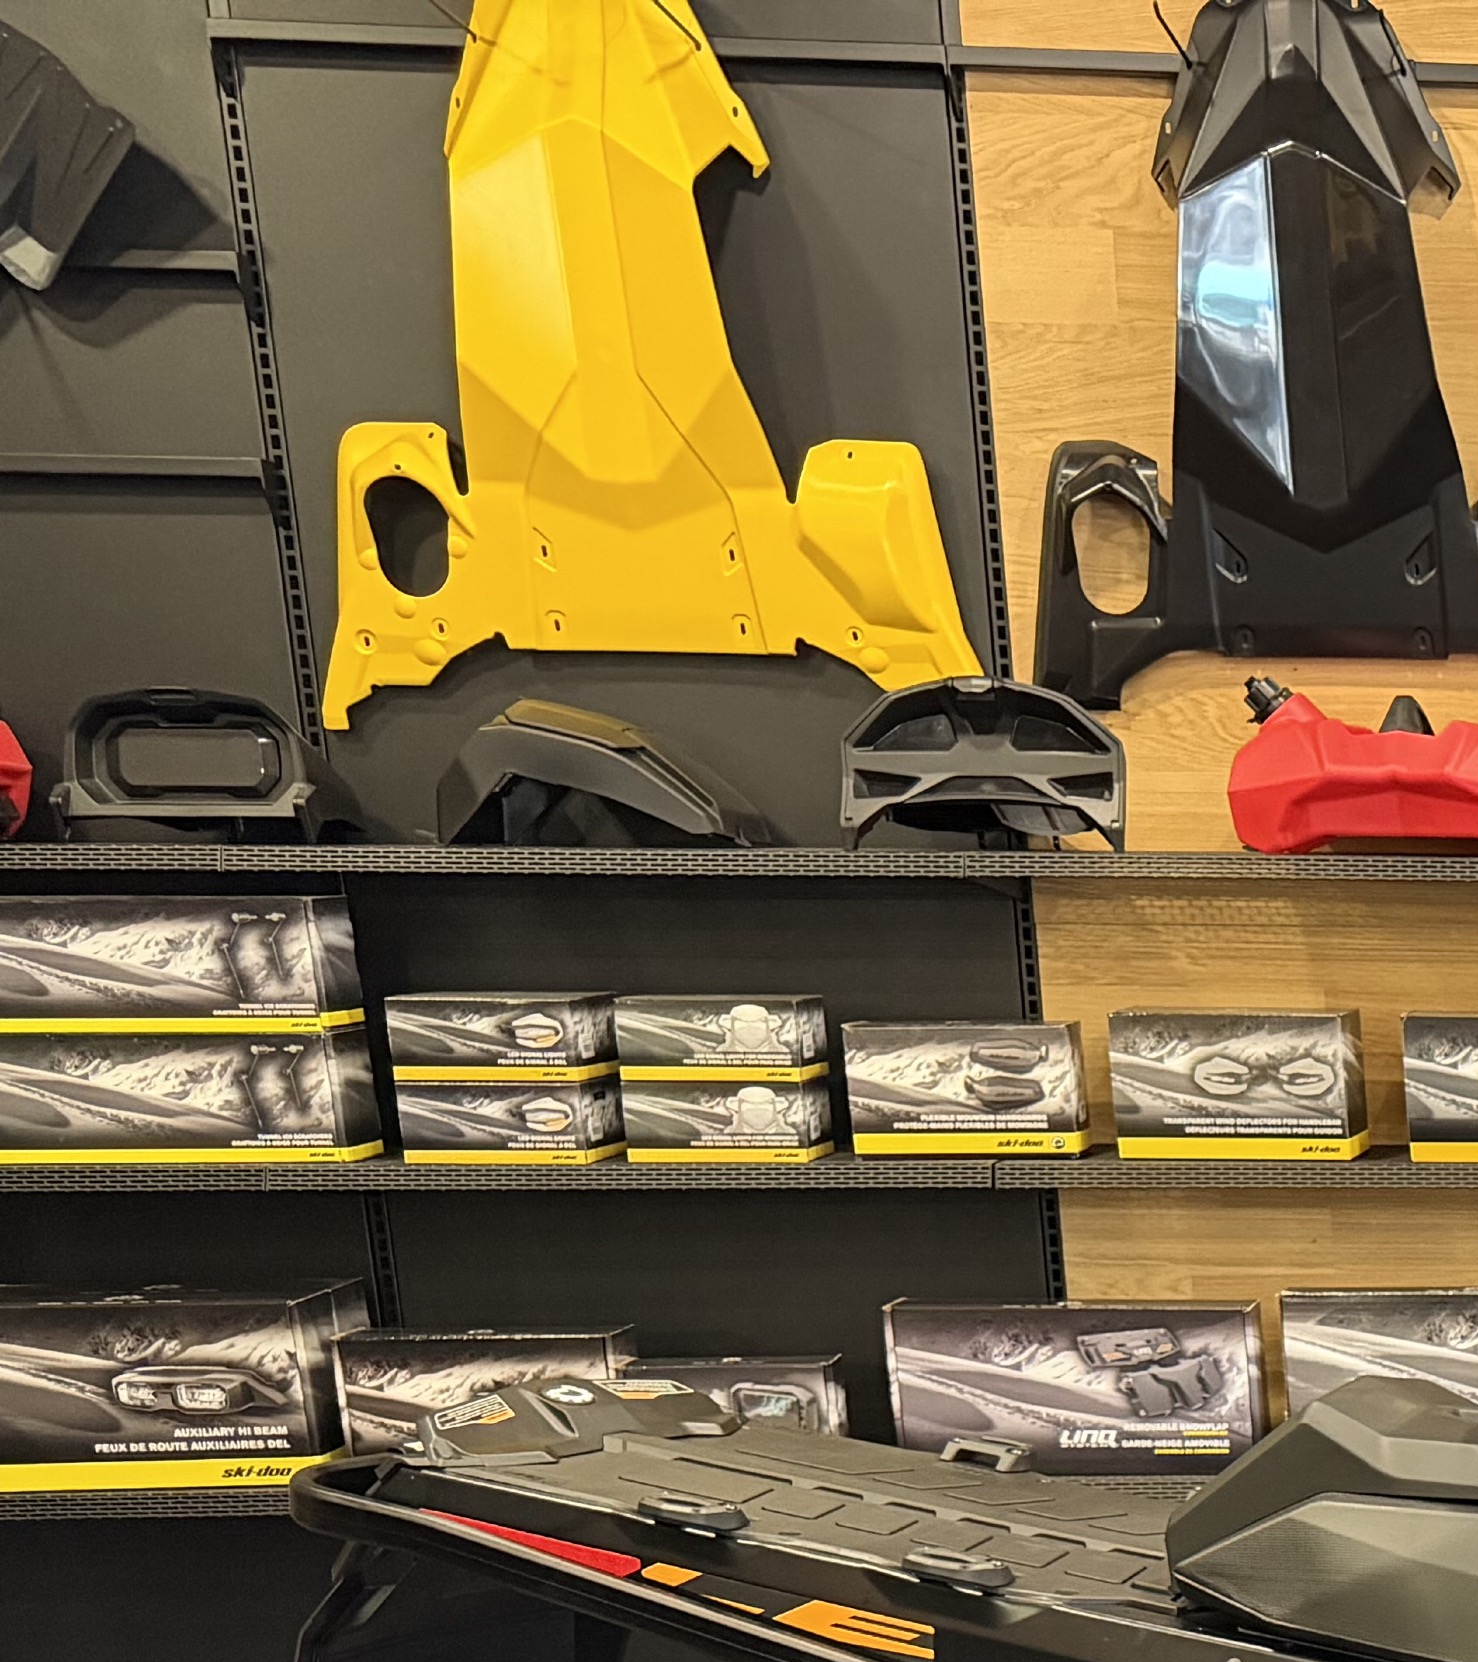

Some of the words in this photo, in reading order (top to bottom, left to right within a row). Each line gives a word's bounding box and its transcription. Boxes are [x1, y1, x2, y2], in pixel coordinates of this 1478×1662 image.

[997, 1139, 1044, 1148] ski-doo
[173, 1427, 235, 1438] AUXILIARY
[238, 1426, 252, 1436] HI
[254, 1425, 288, 1436] BEAM
[95, 1443, 127, 1453] FEUX
[129, 1443, 147, 1452] DE
[148, 1441, 188, 1452] ROUTE
[191, 1440, 265, 1451] AUXILIAIRES
[267, 1439, 291, 1449] DEL
[221, 1465, 292, 1479] ski-doo
